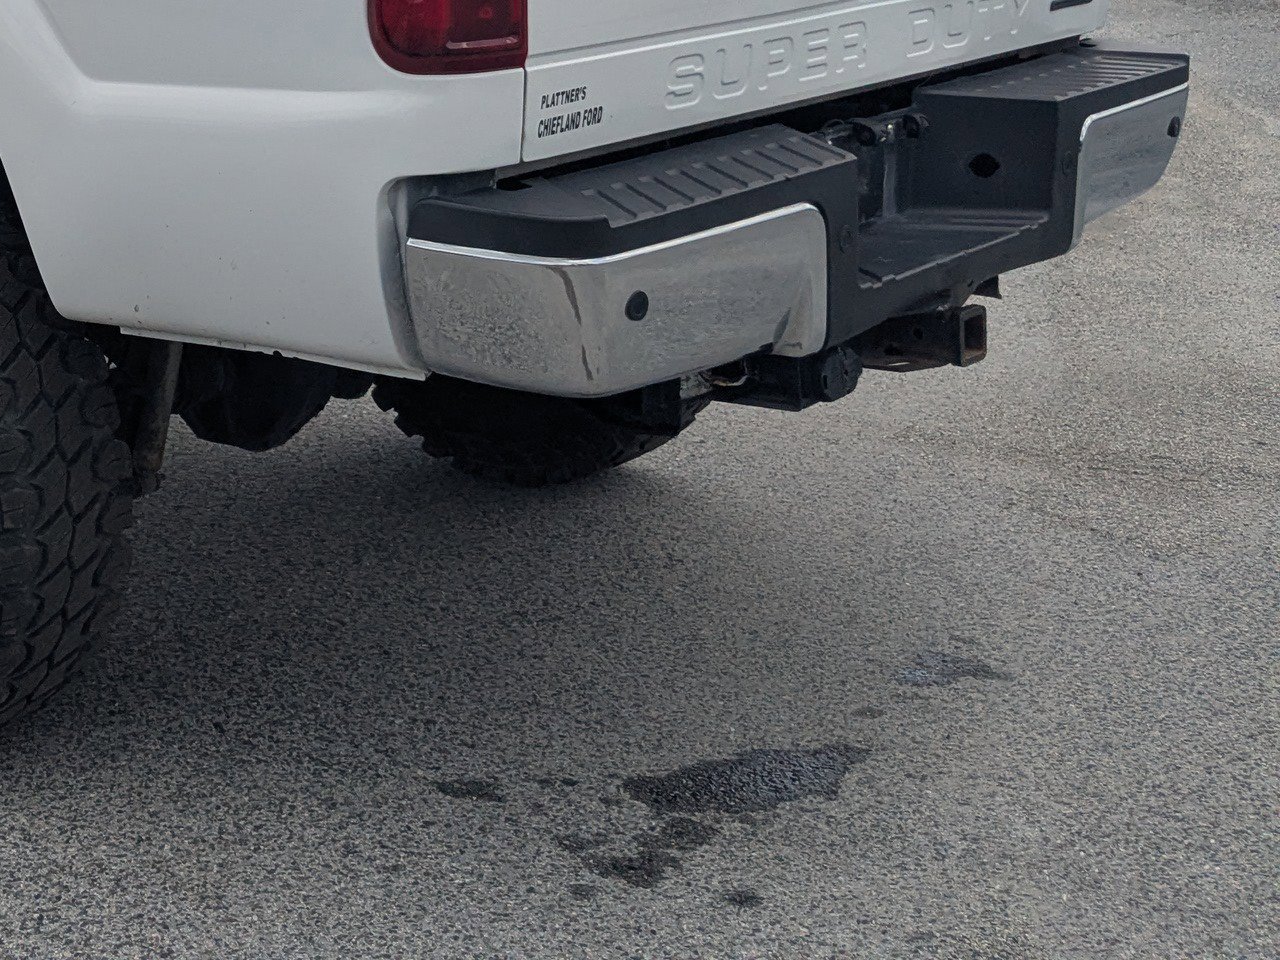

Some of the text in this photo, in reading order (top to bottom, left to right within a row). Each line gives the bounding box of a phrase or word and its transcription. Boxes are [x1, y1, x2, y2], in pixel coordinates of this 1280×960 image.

[664, 20, 868, 111] SUPER
[540, 86, 587, 109] PLATTNER'S
[537, 106, 603, 138] CHIEFLAND FORD
